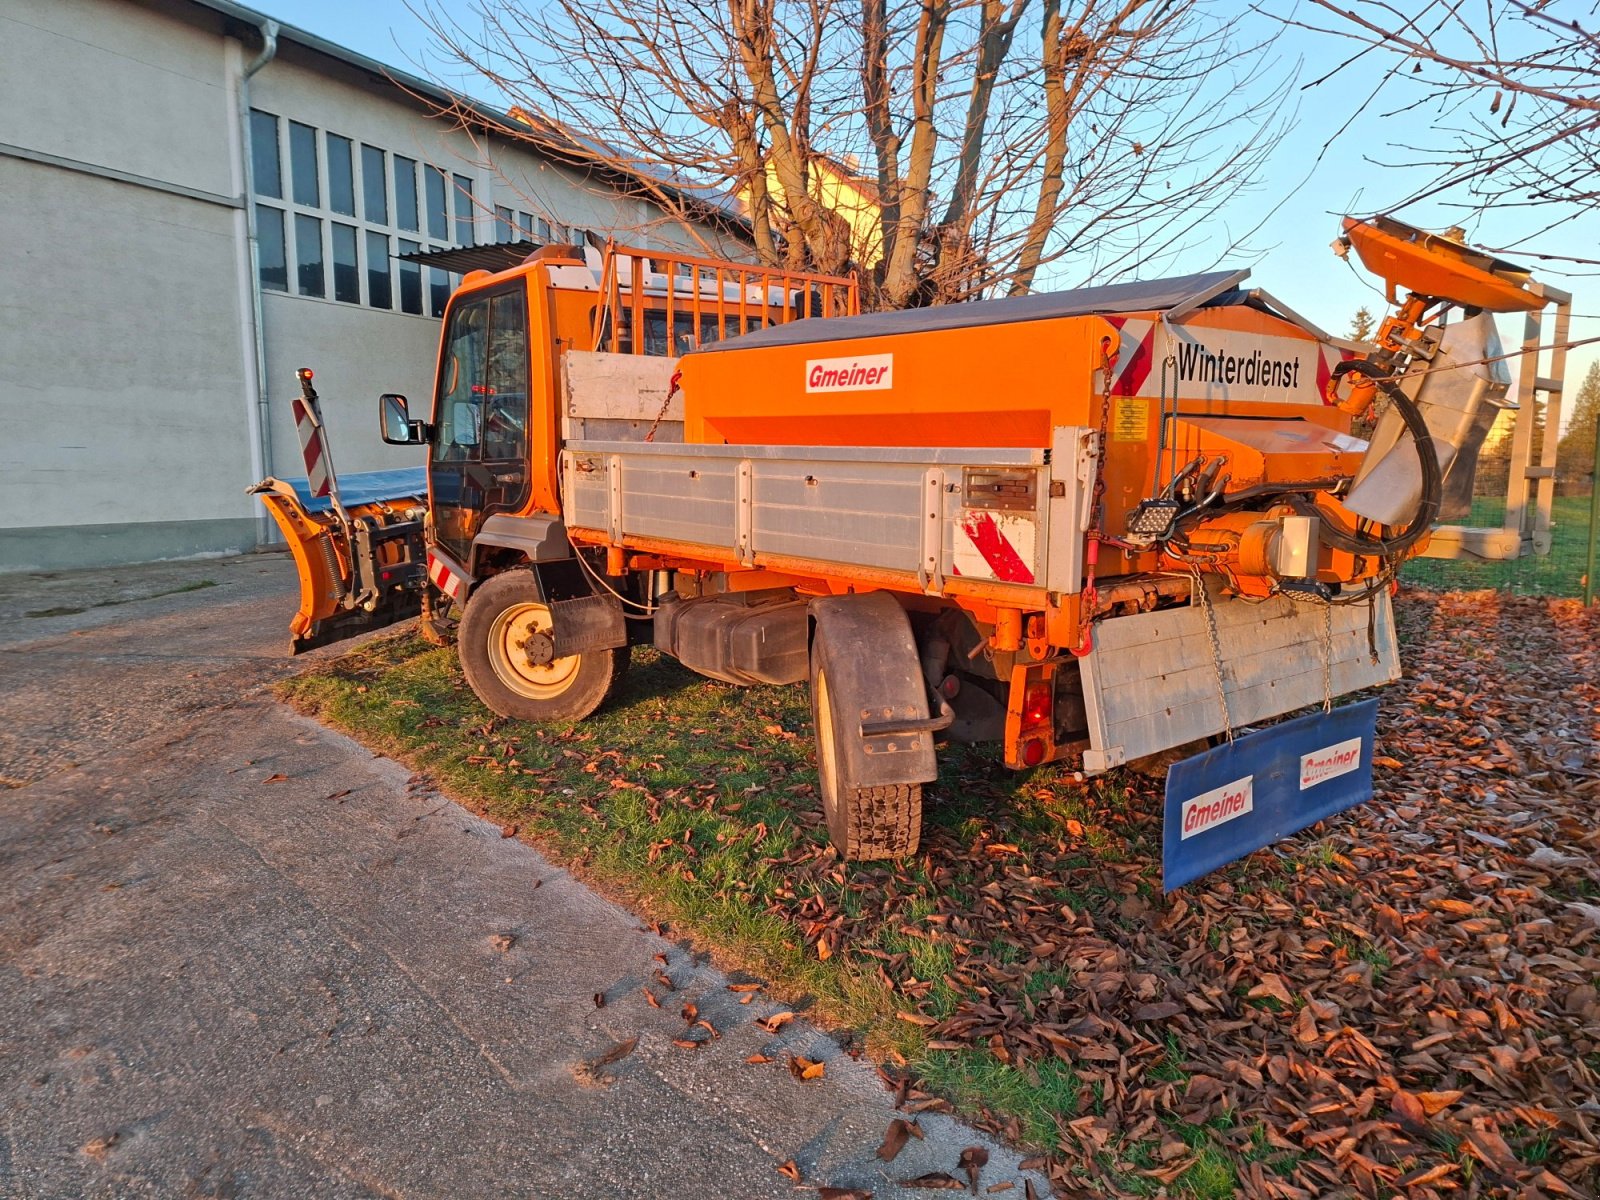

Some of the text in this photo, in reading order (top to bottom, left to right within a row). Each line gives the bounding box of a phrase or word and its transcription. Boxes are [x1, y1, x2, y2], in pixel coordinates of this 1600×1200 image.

[809, 363, 888, 388] Gmeiner
[1178, 342, 1299, 388] Winterdienst
[1184, 789, 1248, 832] Gmeiner
